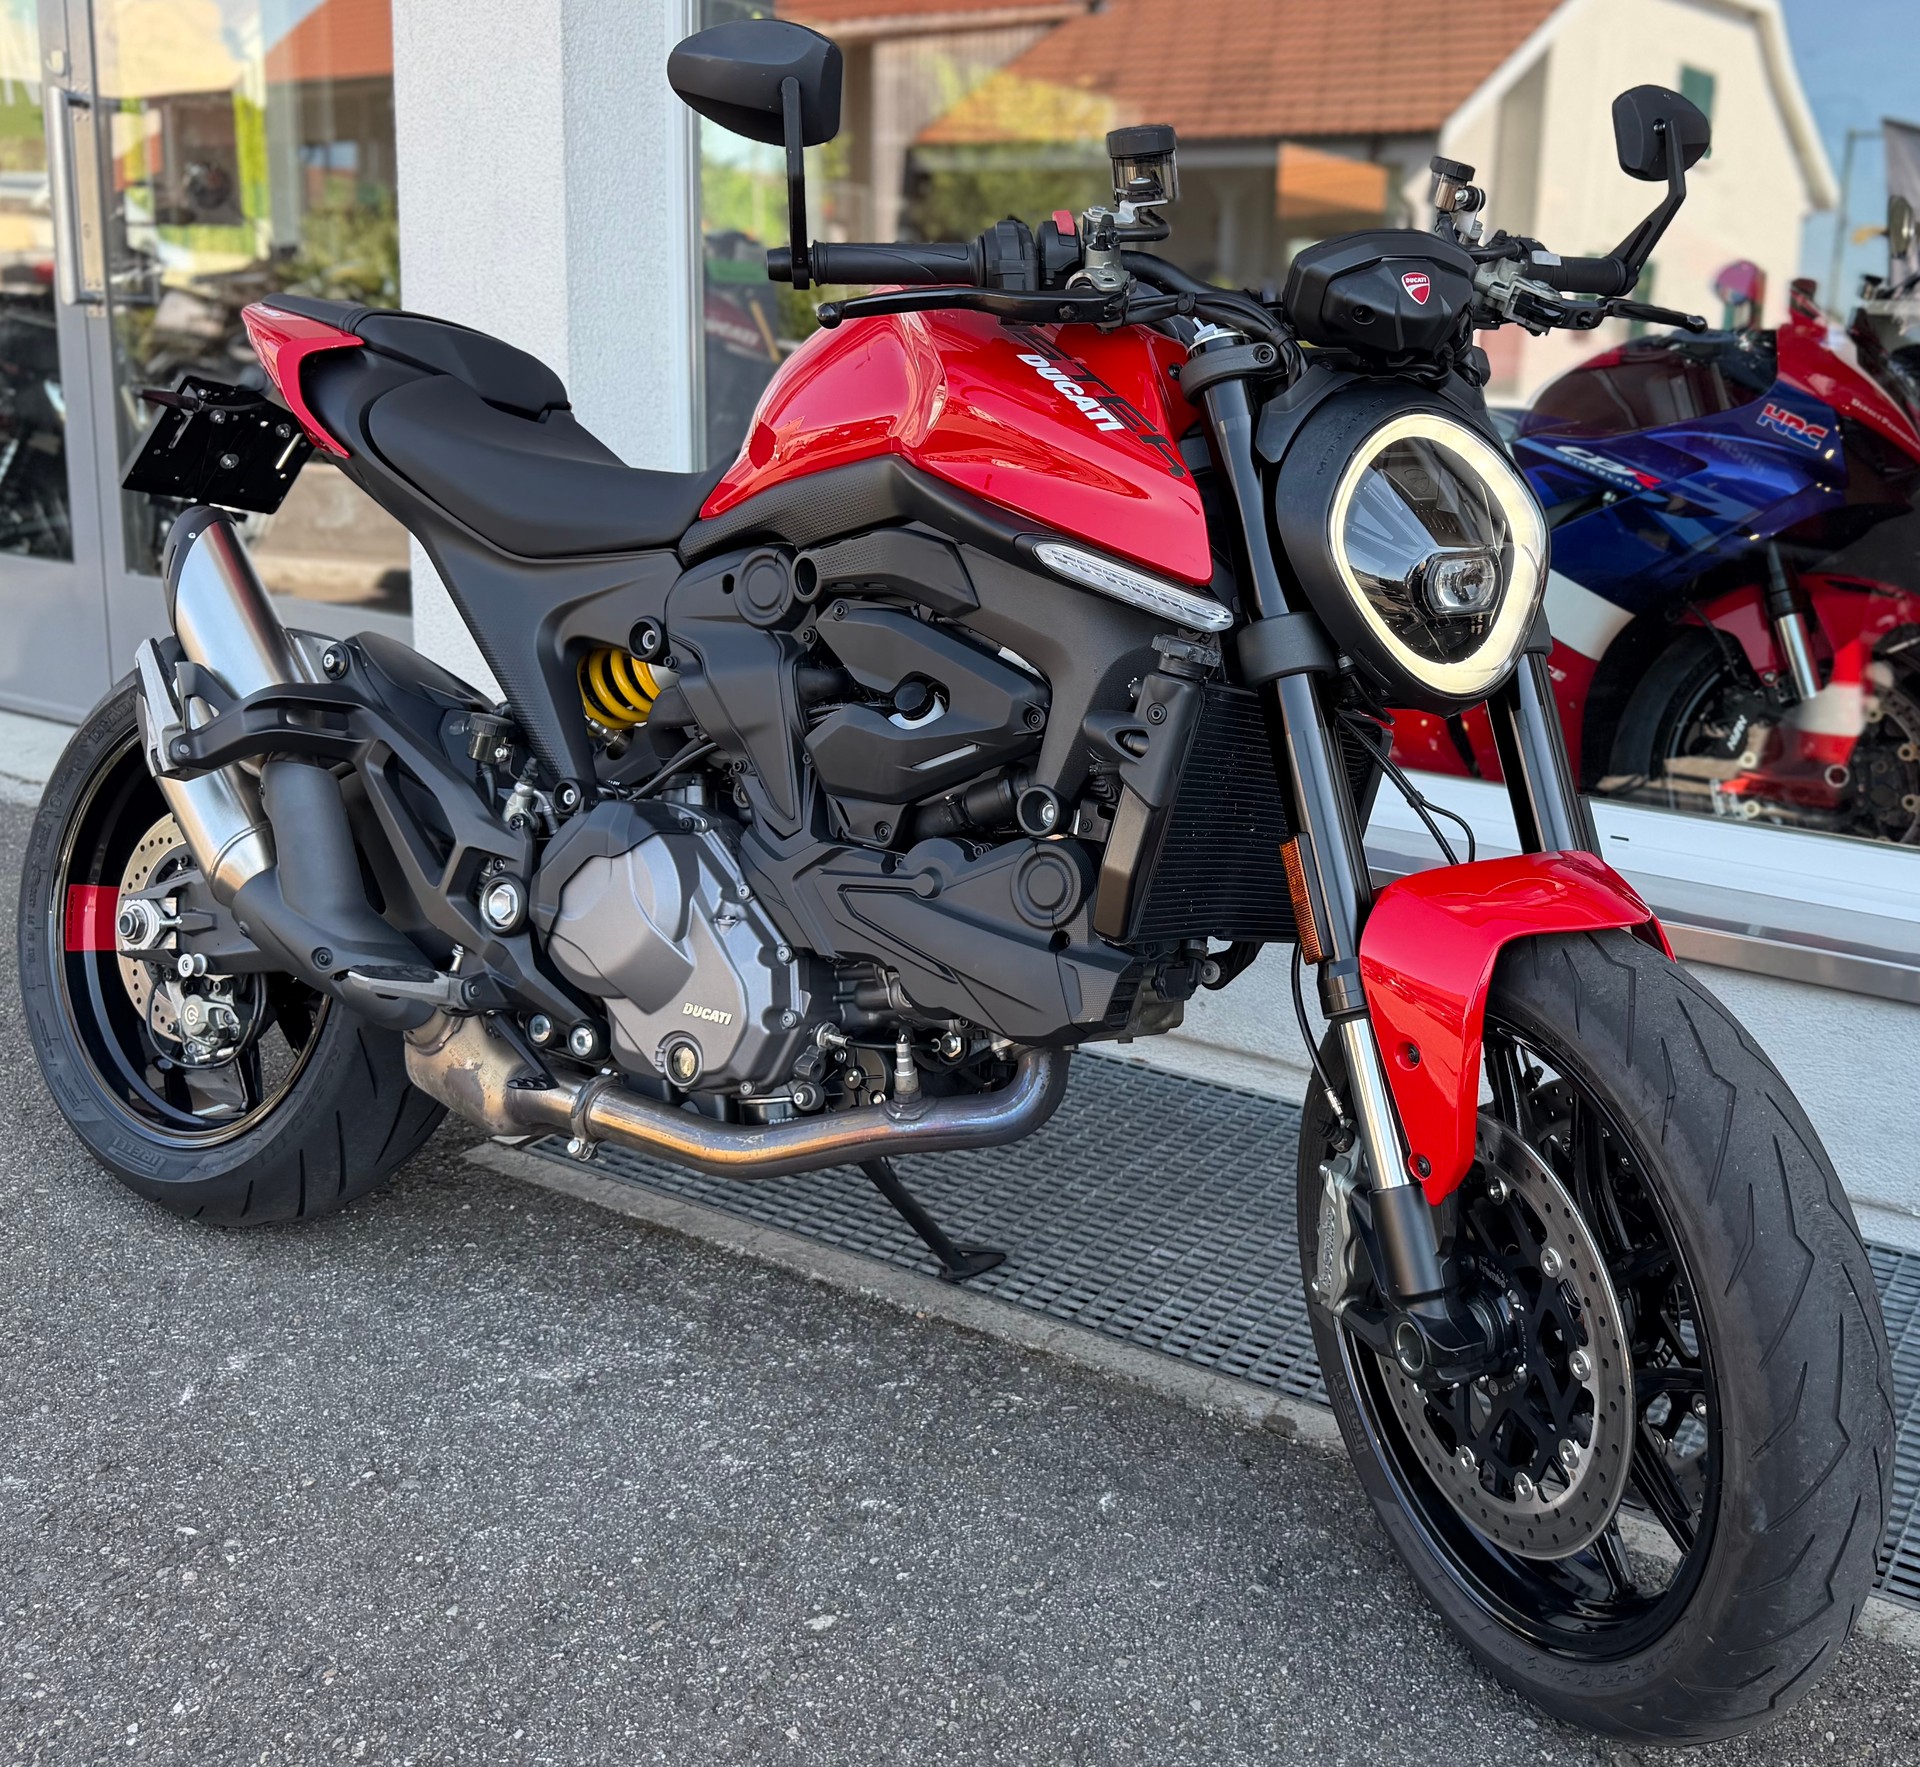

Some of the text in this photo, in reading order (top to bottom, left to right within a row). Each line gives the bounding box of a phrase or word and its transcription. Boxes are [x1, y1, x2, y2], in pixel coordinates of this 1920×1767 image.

[1016, 354, 1125, 431] DUCATI
[1756, 403, 1829, 450] HRC
[1556, 445, 1661, 490] CBR
[682, 1002, 732, 1025] DUCATI
[107, 1136, 168, 1175] PIRELLI
